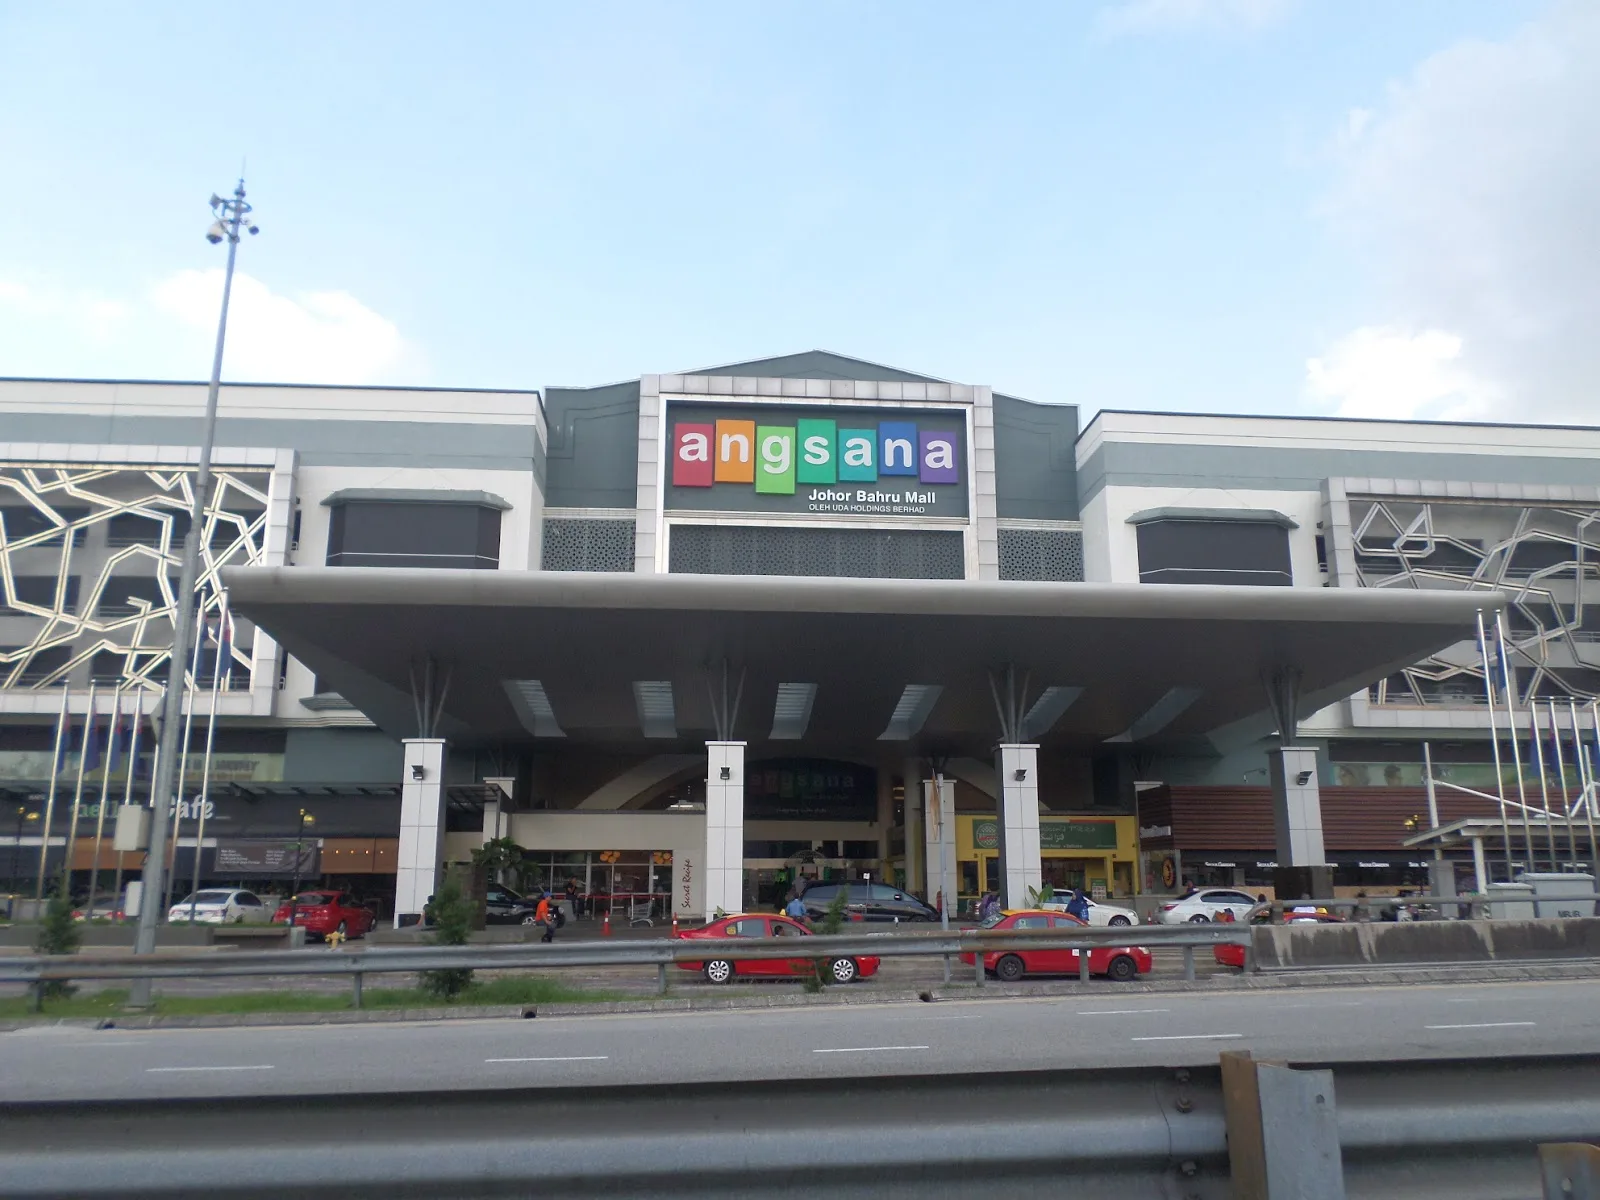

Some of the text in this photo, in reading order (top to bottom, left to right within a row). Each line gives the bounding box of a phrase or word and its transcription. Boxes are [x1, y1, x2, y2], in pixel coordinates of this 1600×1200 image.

[678, 432, 954, 475] angsana
[808, 489, 936, 504] Johor Bahru Mall
[808, 503, 925, 513] OLEH UDA HOLDINGS BERHAD
[681, 858, 694, 909] Secret Recipe
